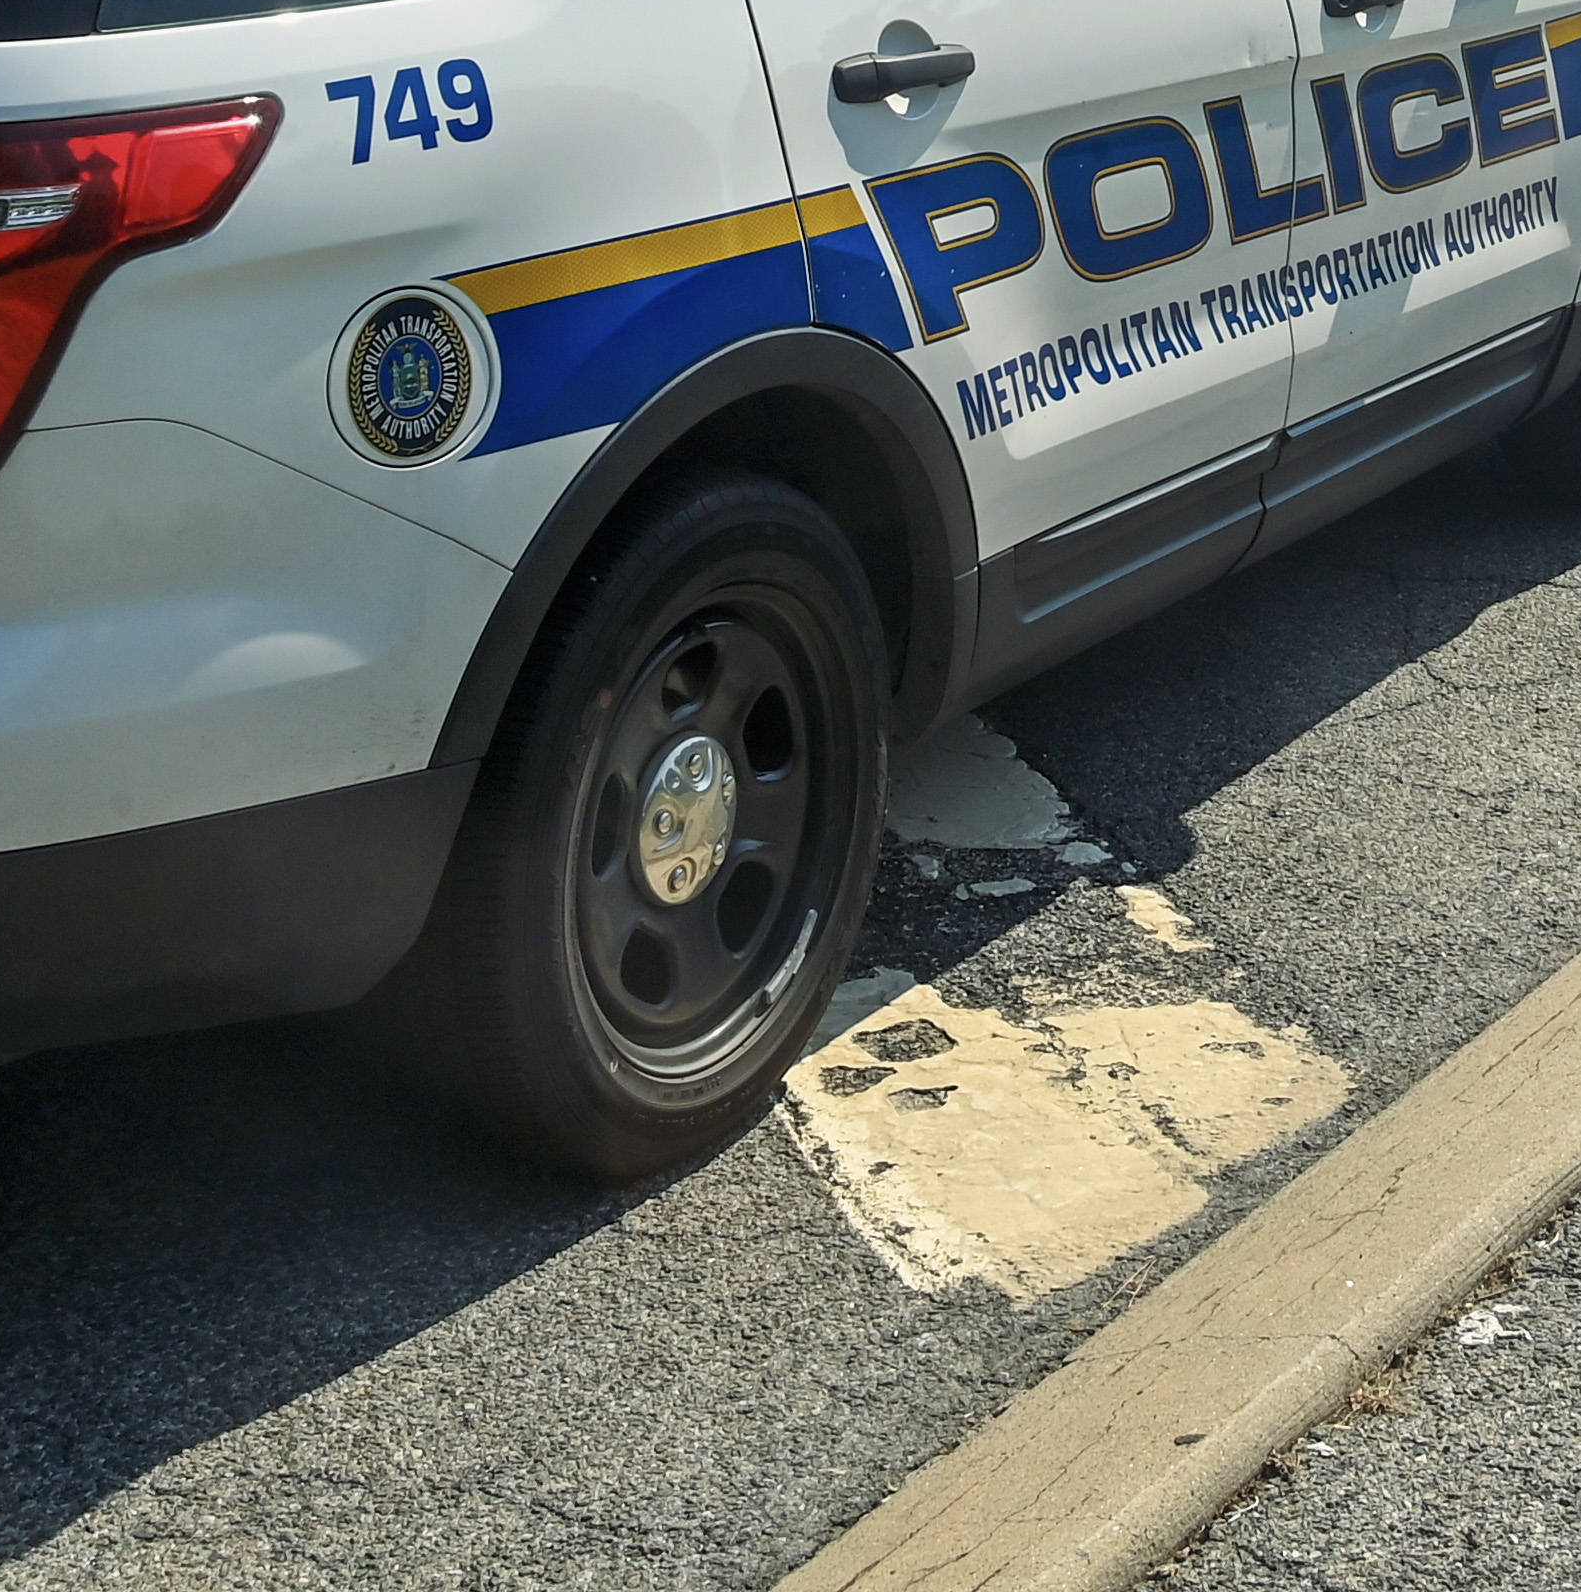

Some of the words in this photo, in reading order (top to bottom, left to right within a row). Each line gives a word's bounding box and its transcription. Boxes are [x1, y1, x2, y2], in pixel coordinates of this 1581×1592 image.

[324, 58, 493, 165] 749
[862, 24, 1561, 346] POLICE
[955, 306, 1204, 442] METROPOLITAN
[1199, 227, 1441, 346] TRANSPORTATION
[1442, 177, 1560, 262] AUTHORITY
[362, 320, 399, 421] METROPOLITAN
[399, 315, 458, 403] TRANSPORTATION
[380, 402, 447, 439] AUTHORITY
